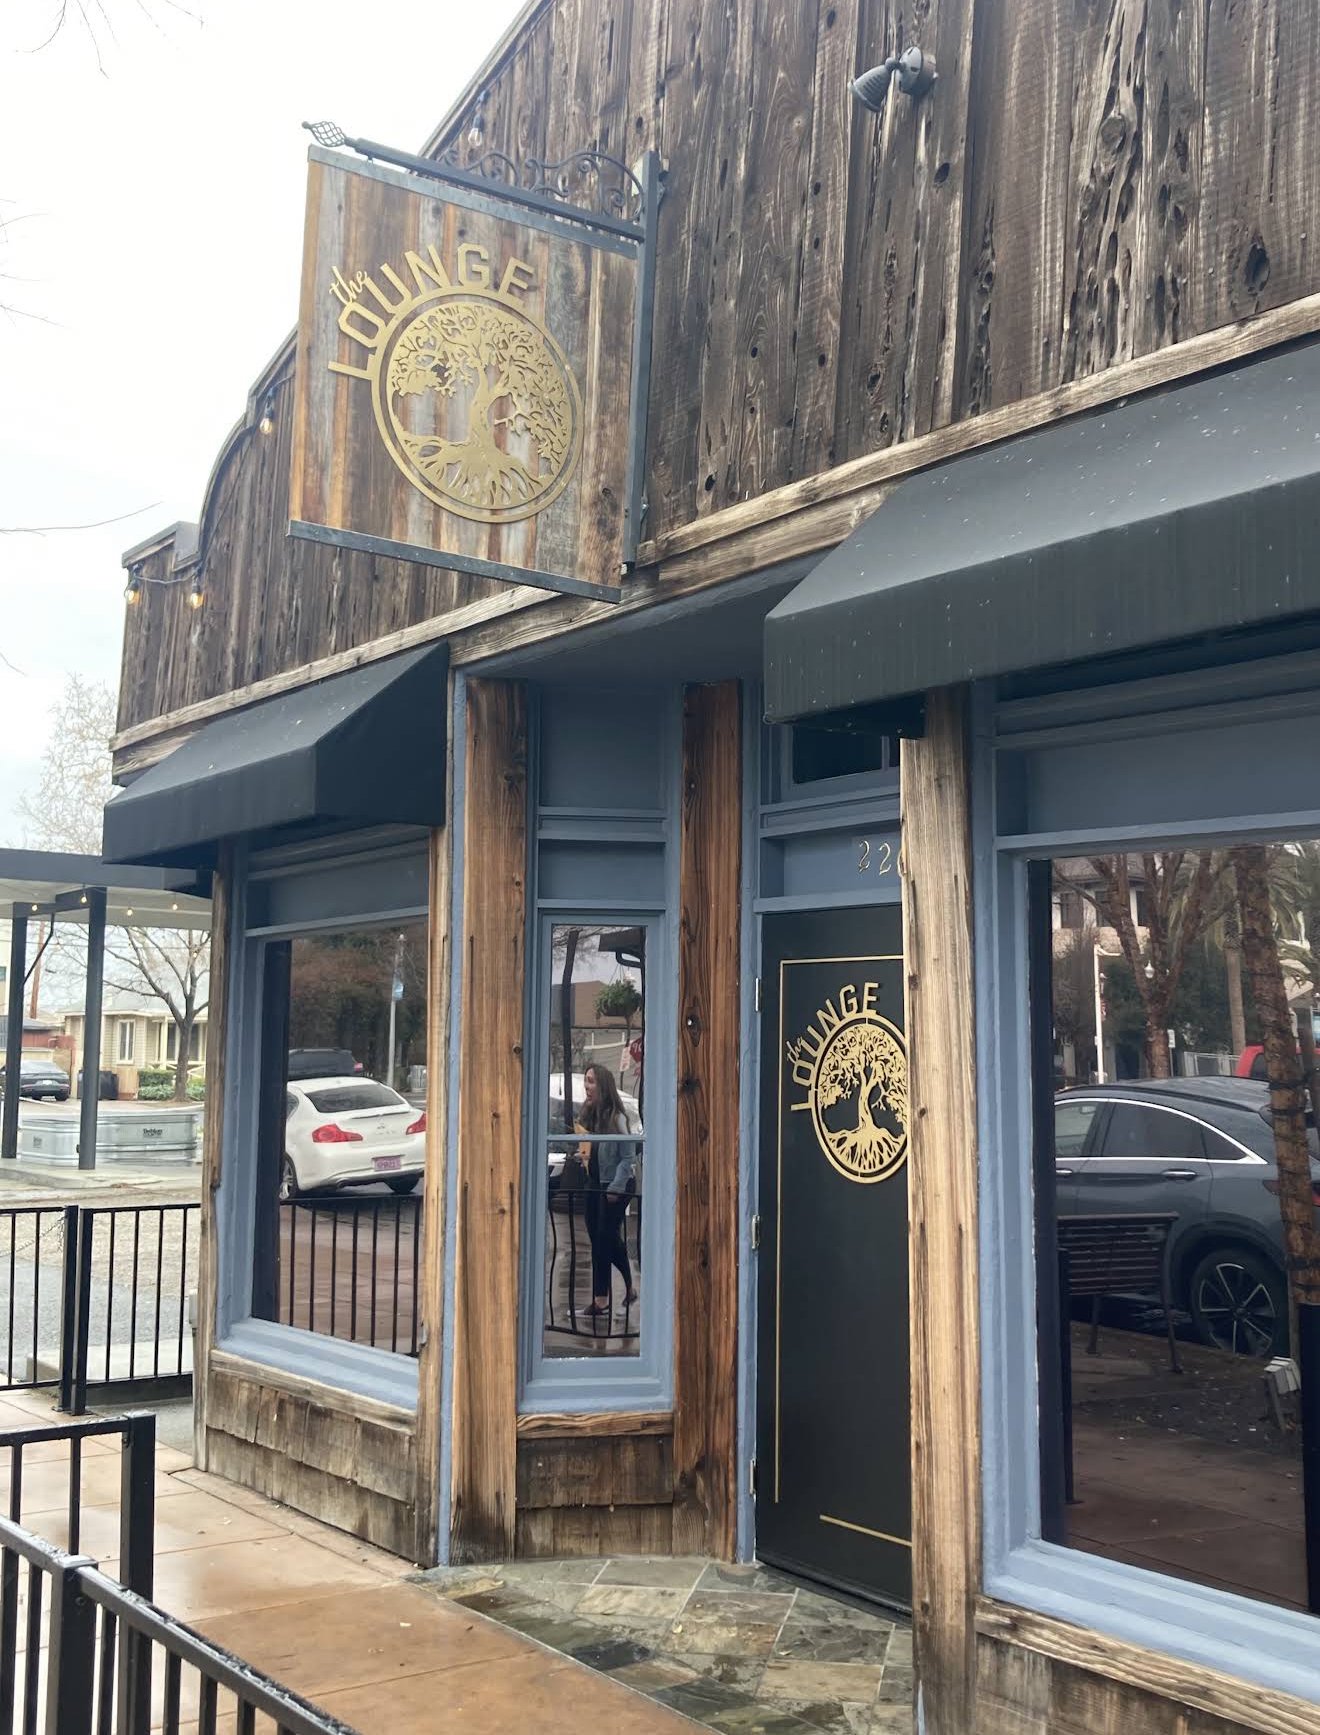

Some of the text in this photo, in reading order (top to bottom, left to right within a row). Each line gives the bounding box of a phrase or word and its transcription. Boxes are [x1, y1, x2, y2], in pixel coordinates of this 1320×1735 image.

[328, 243, 535, 381] LOUNGE
[329, 266, 368, 304] the
[859, 840, 902, 878] 22
[790, 982, 879, 1111] LOUNGE
